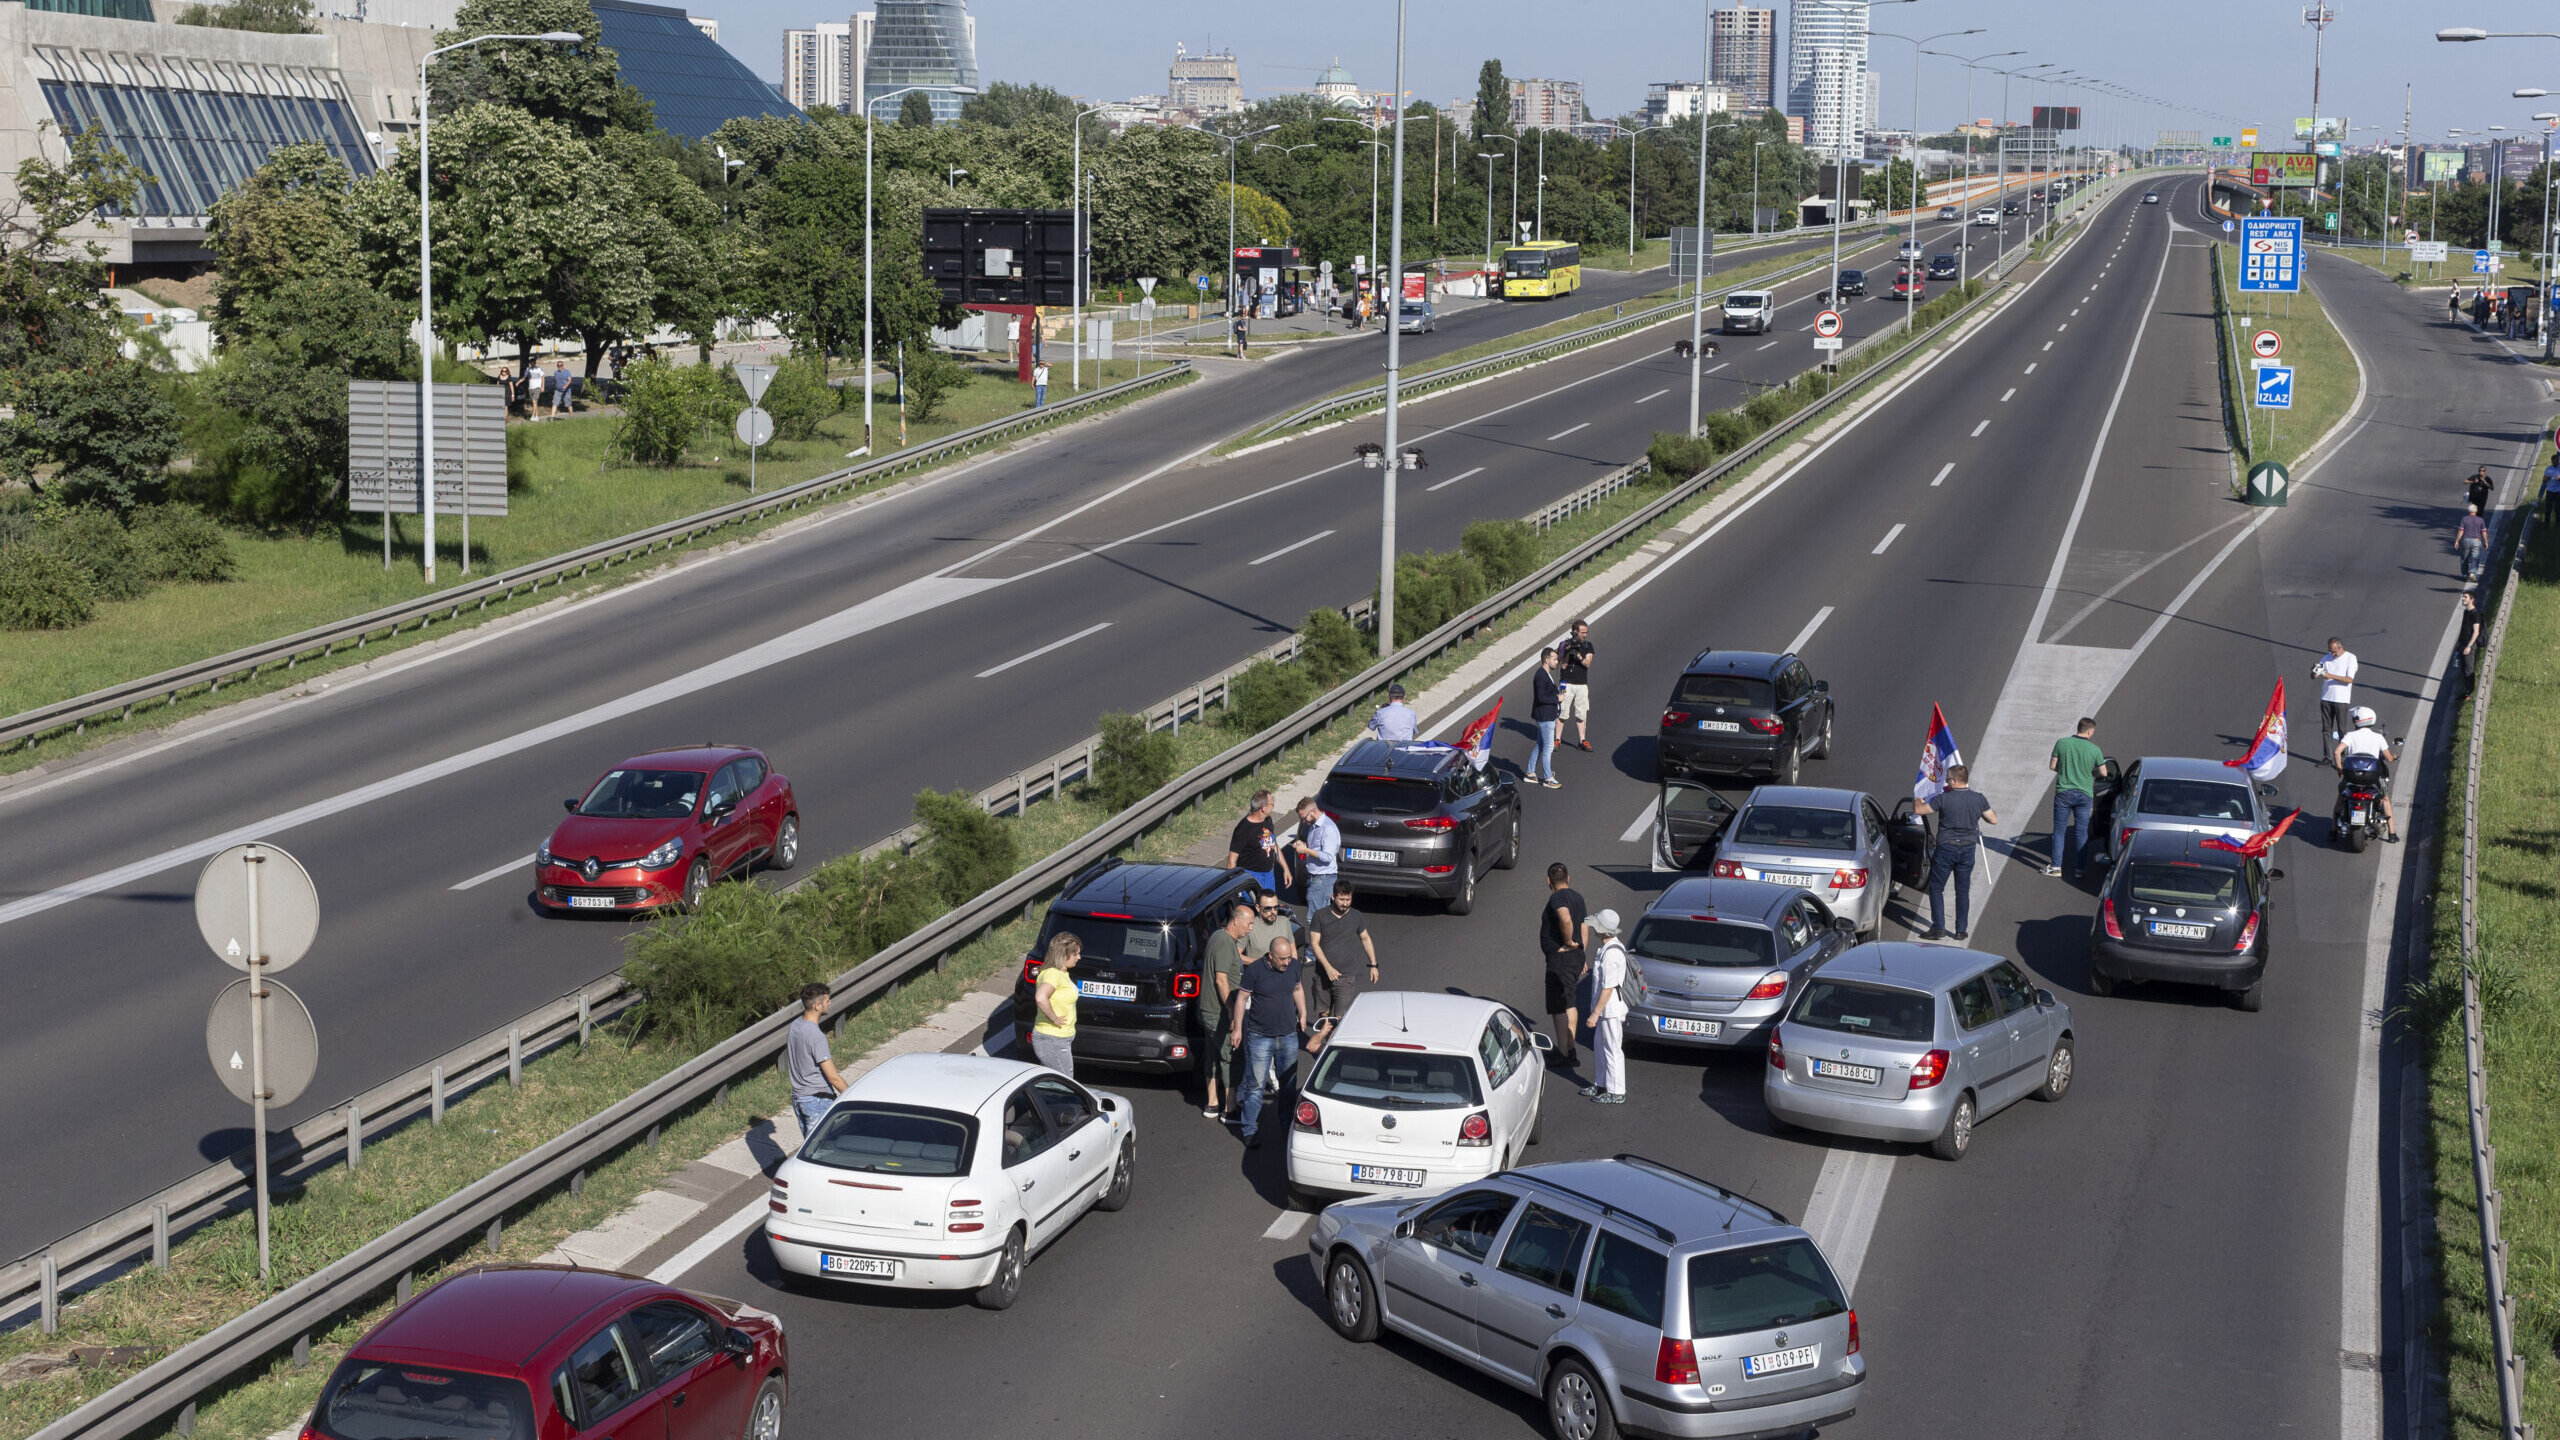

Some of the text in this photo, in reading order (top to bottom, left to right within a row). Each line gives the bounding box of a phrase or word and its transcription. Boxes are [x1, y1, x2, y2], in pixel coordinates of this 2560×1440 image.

[2247, 222, 2297, 230] ОДМОРИШТЕ
[2249, 230, 2294, 238] REST AREA
[2268, 281, 2280, 289] km
[2259, 392, 2289, 403] IZLAZ
[2157, 923, 2168, 933] SM
[1129, 936, 1158, 948] PRESS
[1083, 982, 1094, 993] BG
[1666, 1018, 1678, 1029] SA
[1821, 1062, 1832, 1073] BG
[1360, 1166, 1374, 1179] BG
[829, 1256, 842, 1269] BG
[1753, 1357, 1766, 1372] SI
